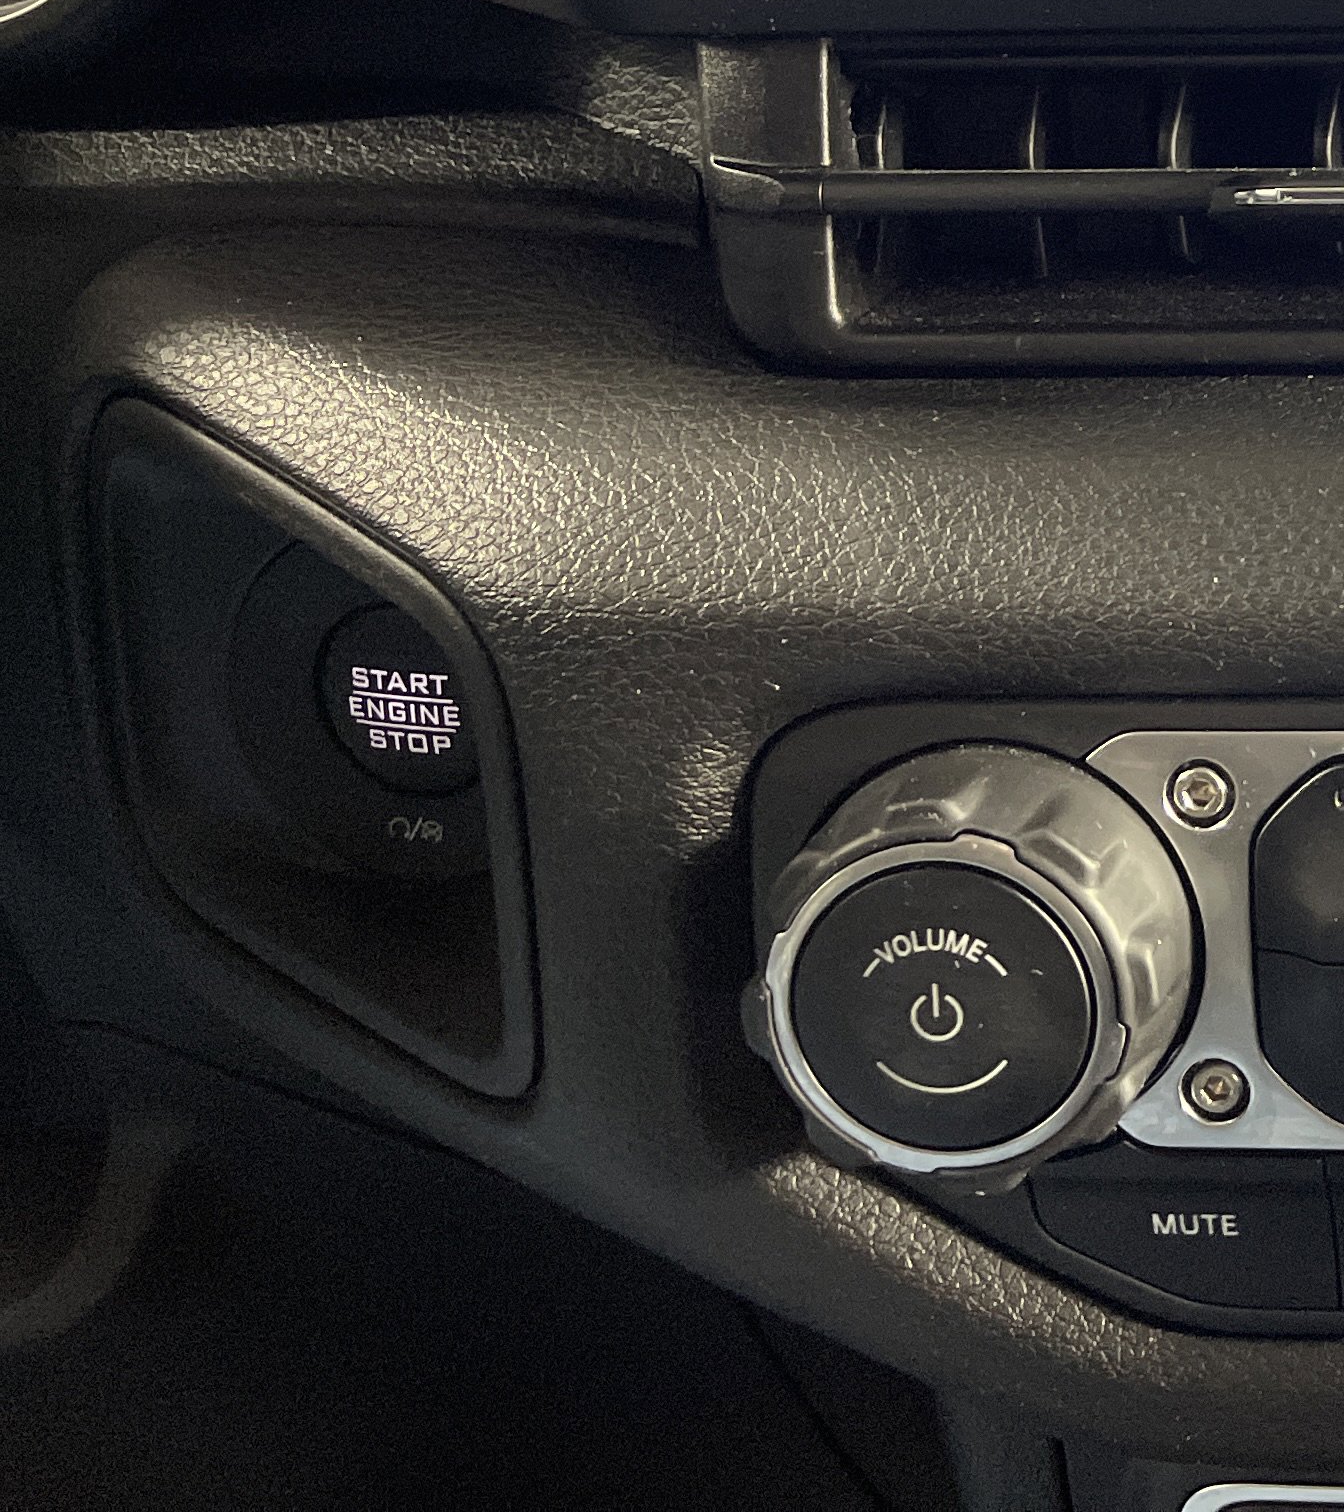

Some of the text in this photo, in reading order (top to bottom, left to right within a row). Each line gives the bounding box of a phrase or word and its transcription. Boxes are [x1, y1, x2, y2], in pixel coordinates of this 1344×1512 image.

[351, 666, 449, 696] START
[348, 695, 461, 727] ENGINE
[368, 727, 452, 755] STOP
[873, 927, 988, 964] VOLUME
[1150, 1213, 1240, 1237] MUTE
